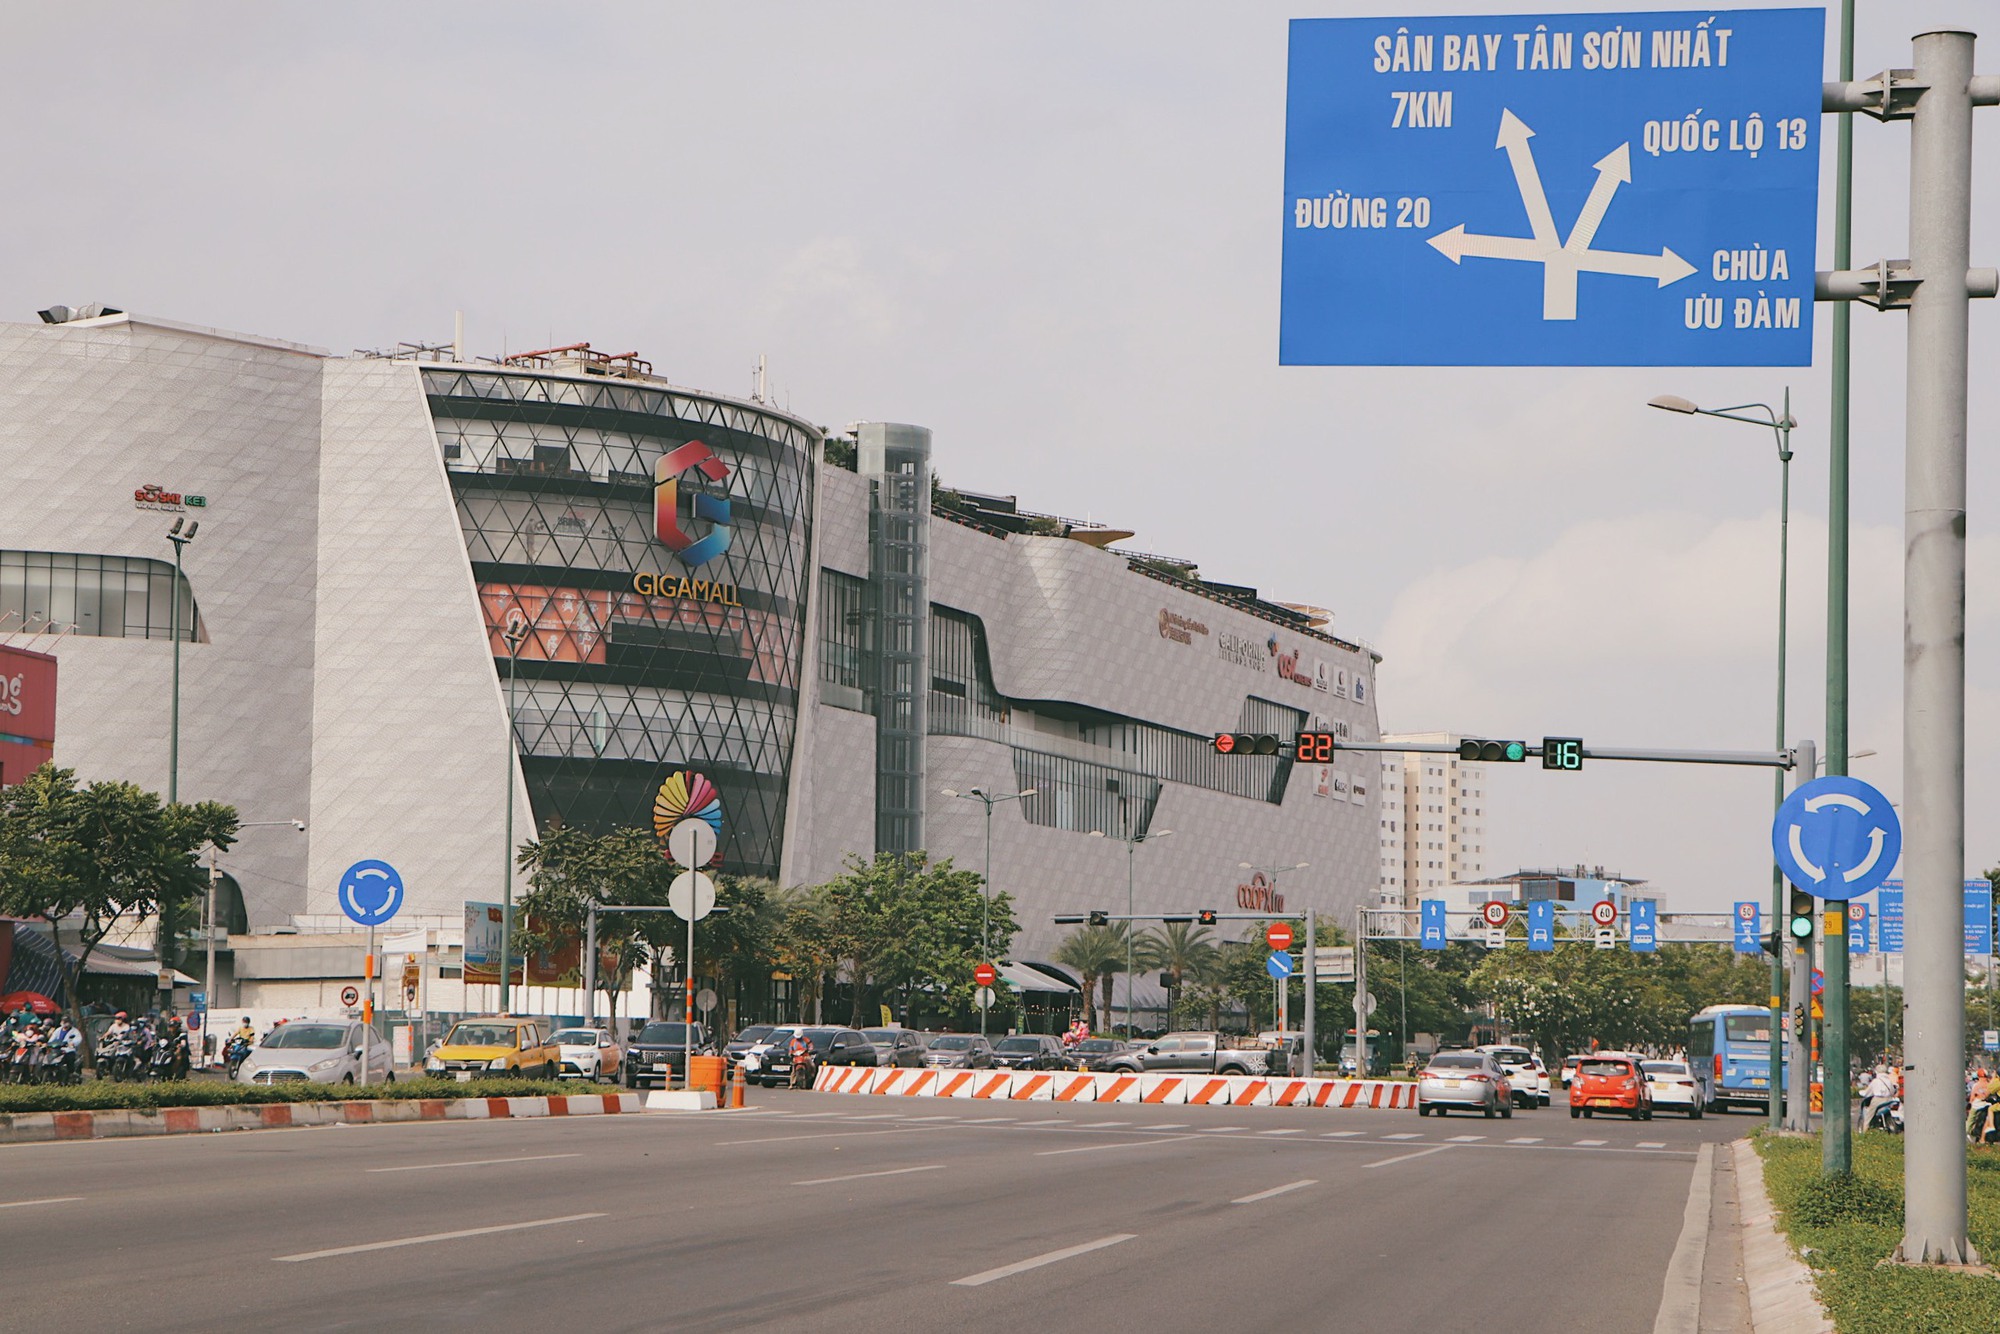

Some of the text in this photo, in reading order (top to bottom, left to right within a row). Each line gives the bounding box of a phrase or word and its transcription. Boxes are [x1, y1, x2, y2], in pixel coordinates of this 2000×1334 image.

[1374, 17, 1732, 72] SÂN BAY TÂN SƠN NHẤT
[1391, 91, 1452, 128] 7KM
[1643, 109, 1807, 158] QUỐC LỘ 13
[1295, 190, 1431, 228] ĐƯỜNG 20
[1713, 243, 1789, 281] CHÙA
[1685, 290, 1800, 329] ƯU ĐÀM
[185, 495, 206, 507] KEI
[634, 573, 742, 607] GIGAMALL
[1298, 734, 1332, 761] 22
[1557, 742, 1579, 769] 16
[1490, 907, 1501, 918] 80
[1600, 907, 1611, 918] 60
[1742, 908, 1752, 917] 50
[1852, 909, 1861, 918] 50
